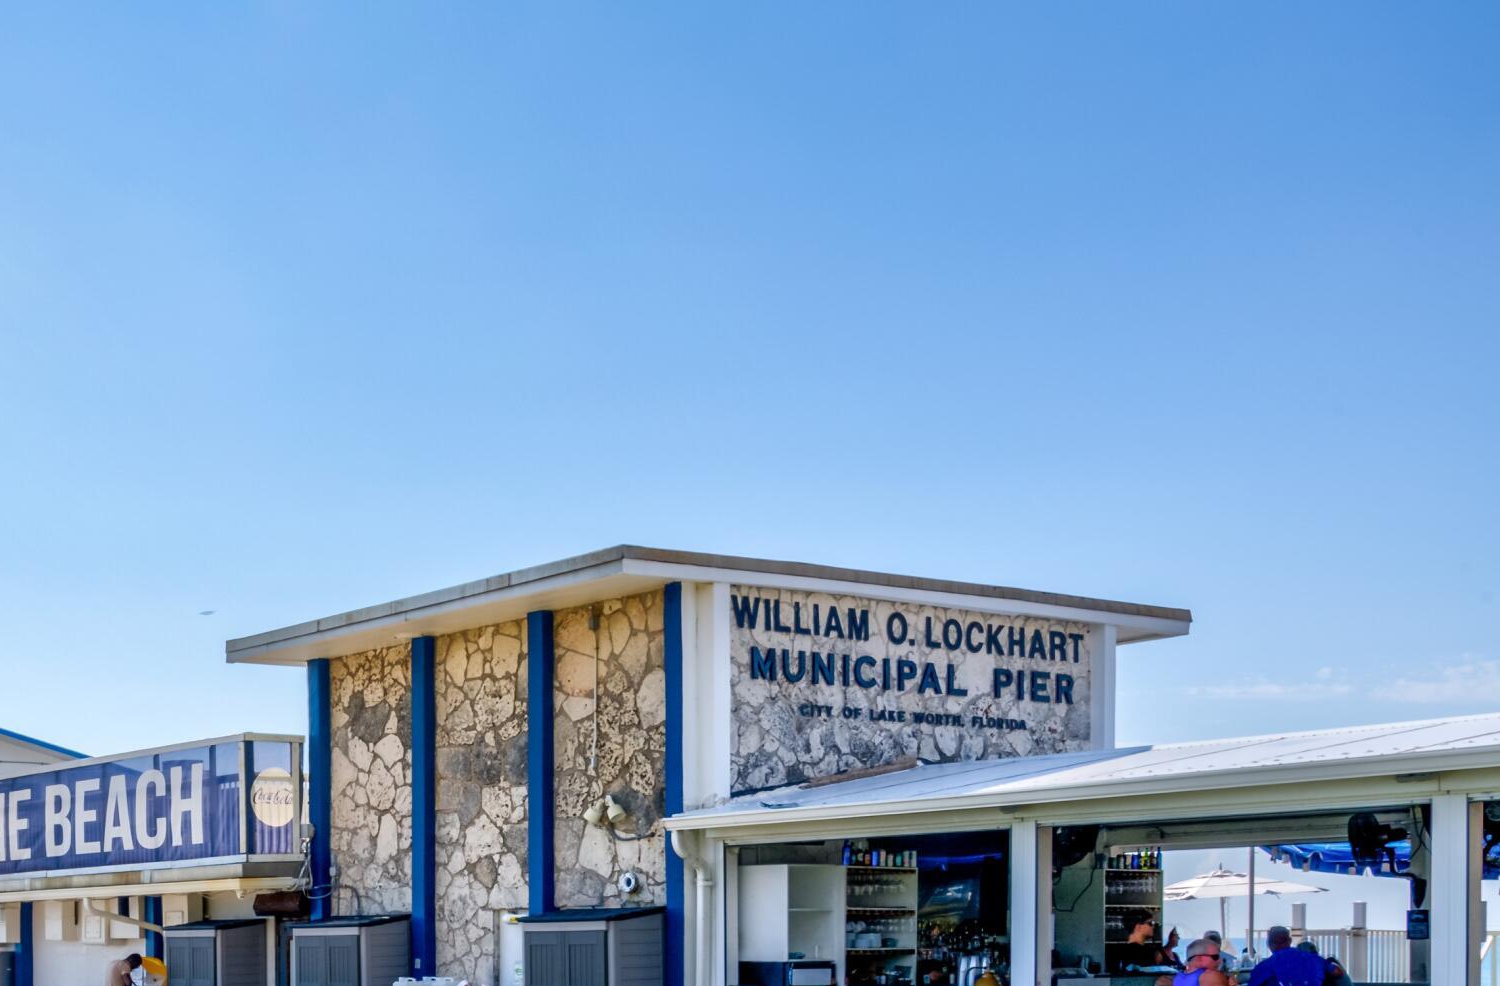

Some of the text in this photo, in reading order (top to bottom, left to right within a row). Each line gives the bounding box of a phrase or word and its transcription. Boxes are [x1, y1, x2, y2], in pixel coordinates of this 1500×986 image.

[731, 594, 1084, 663] WILLIAM O. LOCKHART
[750, 646, 1074, 704] MUNICIPAL PIER
[799, 704, 833, 718] CITY
[843, 706, 861, 719] OF
[870, 709, 905, 723] LAKE
[972, 716, 1027, 731] FLORIDA
[45, 763, 205, 858] BEACH
